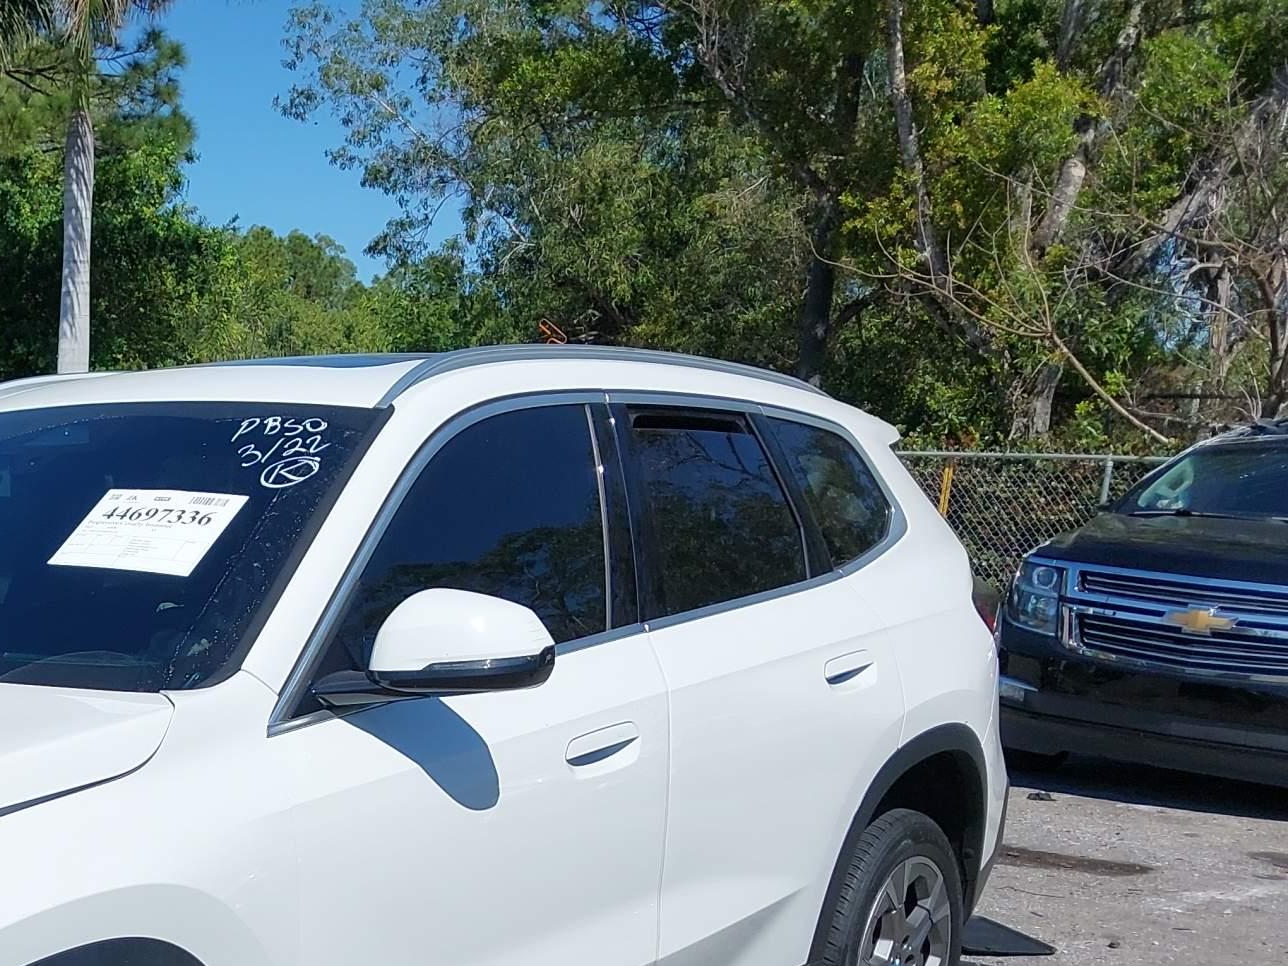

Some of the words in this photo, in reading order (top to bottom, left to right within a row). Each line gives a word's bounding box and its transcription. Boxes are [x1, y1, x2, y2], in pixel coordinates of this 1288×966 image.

[231, 416, 328, 442] PBSO
[237, 434, 332, 467] 3/22
[102, 506, 217, 526] 44697336
